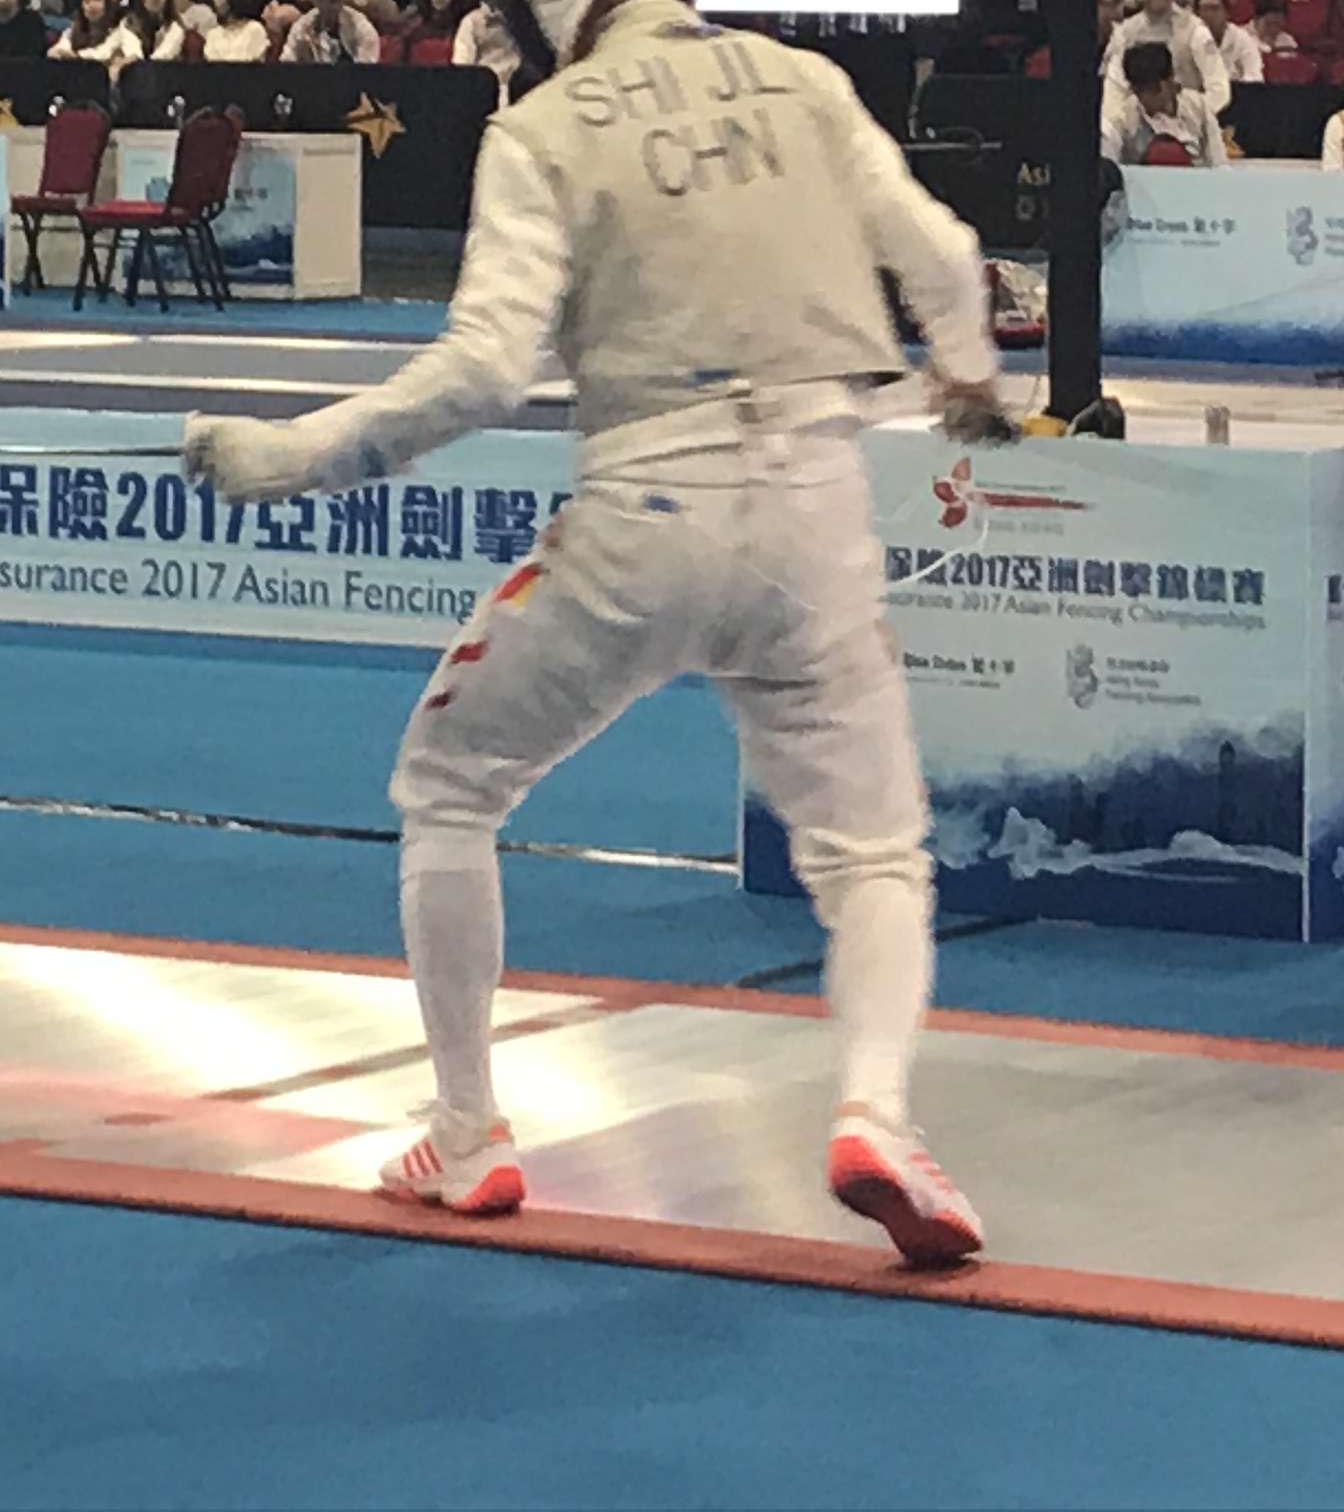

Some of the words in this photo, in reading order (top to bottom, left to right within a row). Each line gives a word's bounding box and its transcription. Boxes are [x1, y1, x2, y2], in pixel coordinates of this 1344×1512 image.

[564, 54, 689, 128] SHI
[640, 107, 786, 198] CHN
[141, 559, 228, 602] 2017
[232, 564, 330, 608] Asian
[344, 569, 477, 626] Fencing
